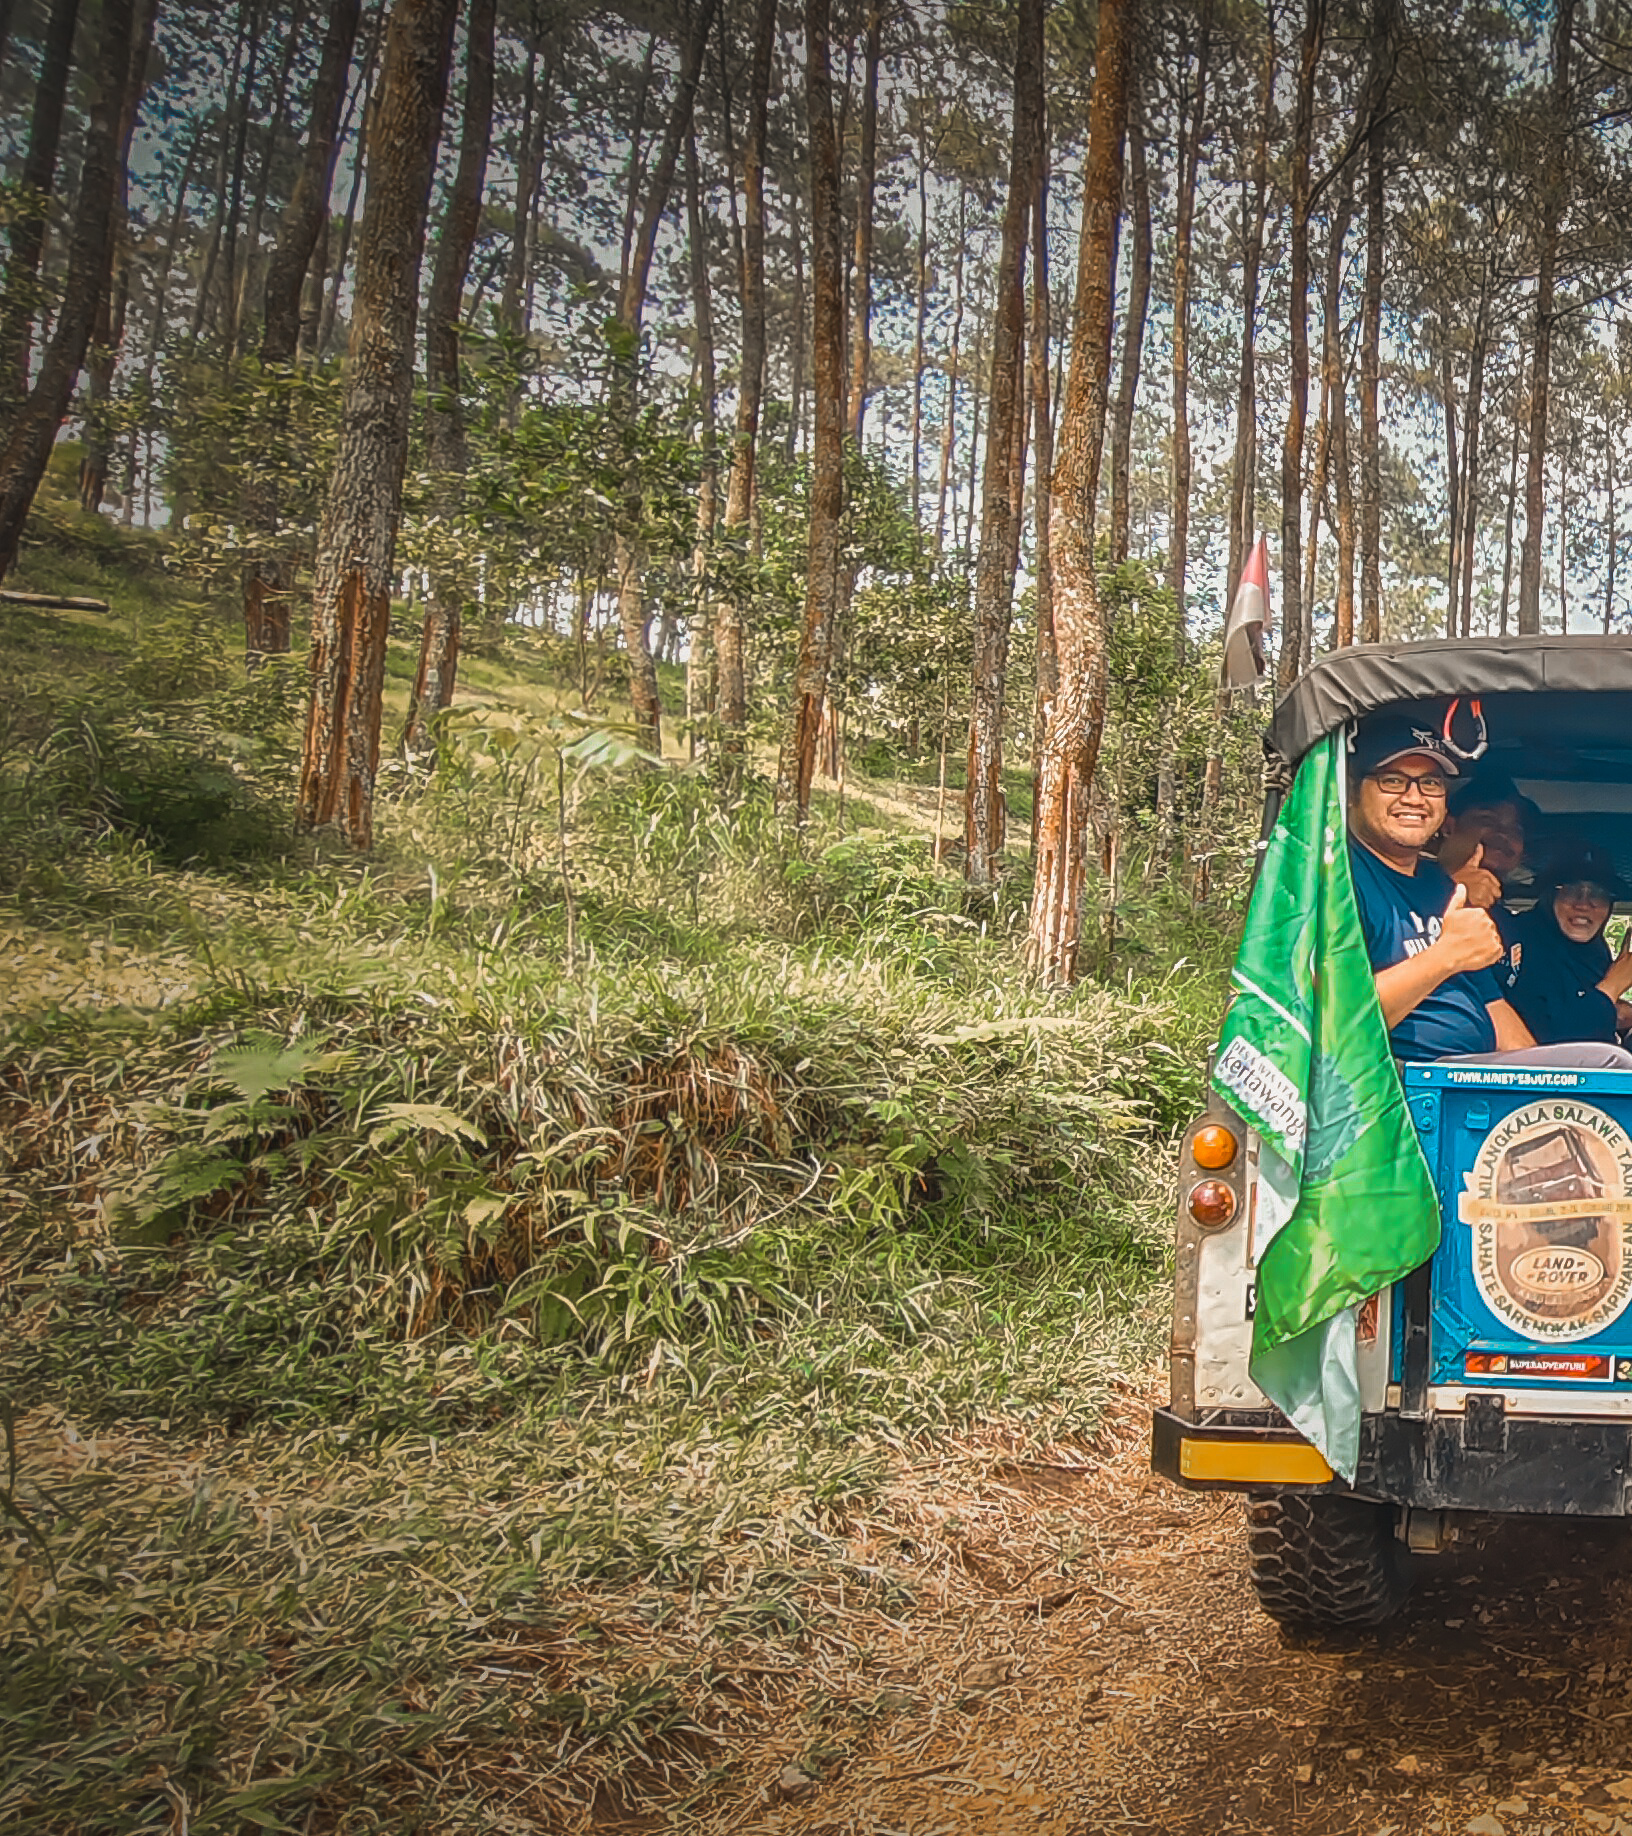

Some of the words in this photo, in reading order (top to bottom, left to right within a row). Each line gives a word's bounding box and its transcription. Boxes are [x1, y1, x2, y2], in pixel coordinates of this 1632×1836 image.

[1221, 1050, 1305, 1136] kertawang
[1478, 1107, 1549, 1200] MILANGKALA
[1553, 1105, 1622, 1149] SALAWE
[1478, 1223, 1498, 1295] SAHATE
